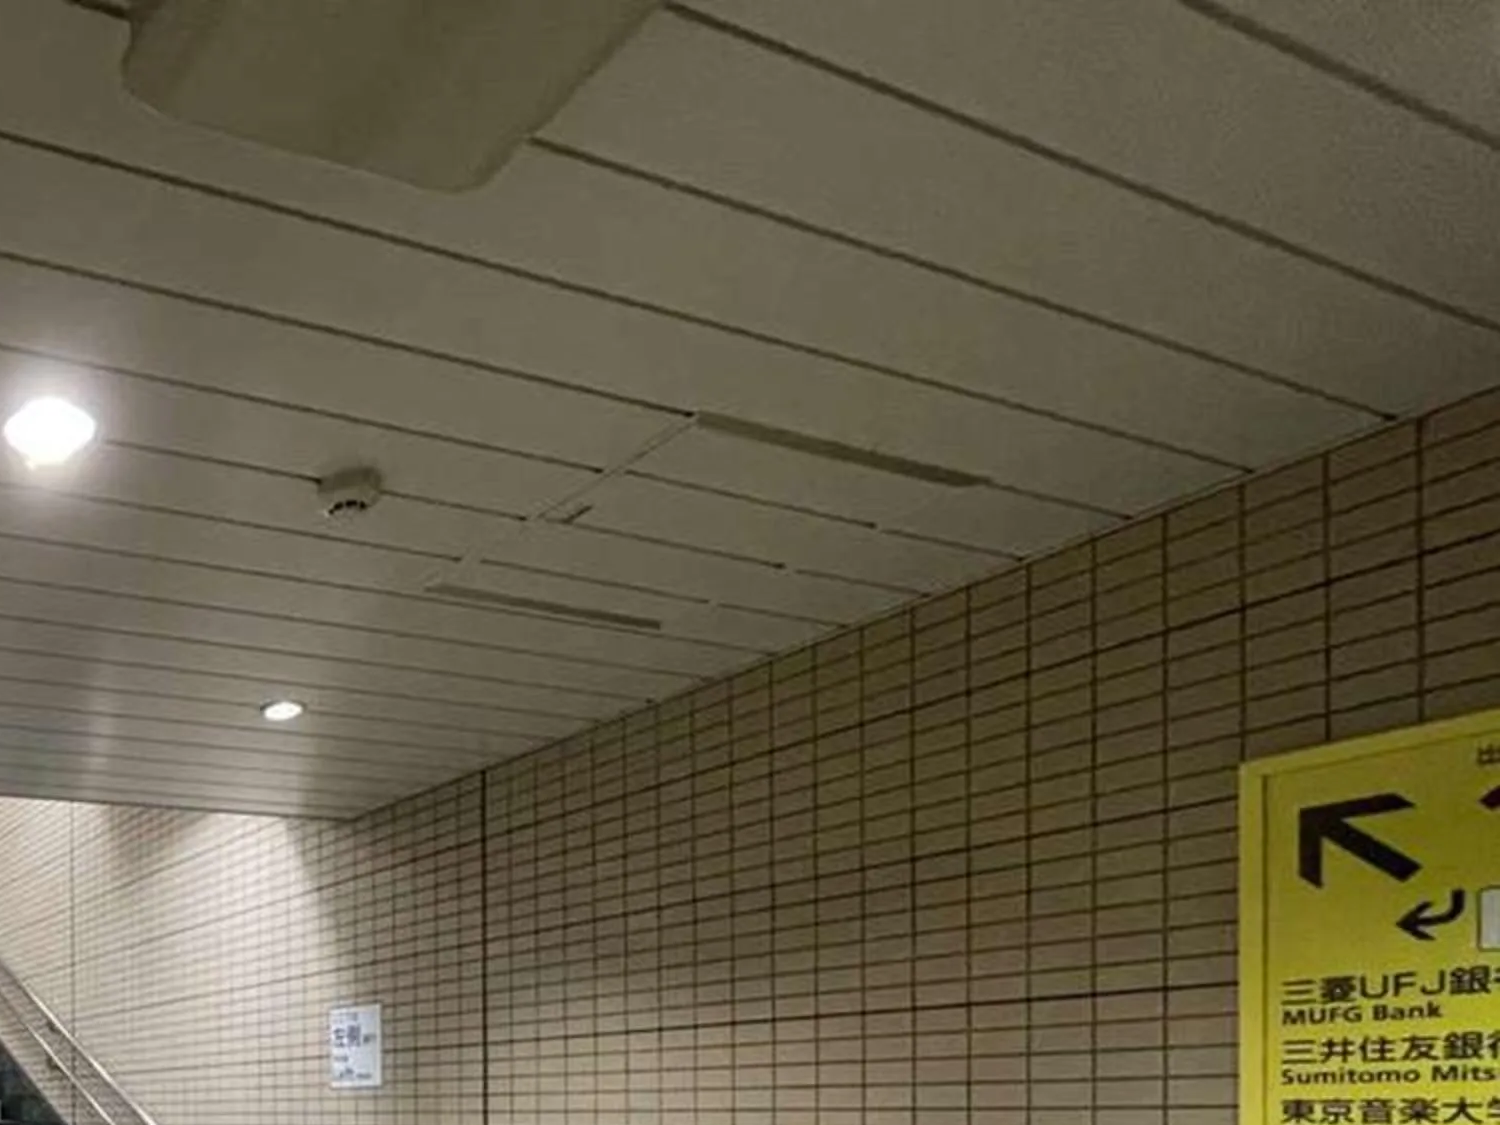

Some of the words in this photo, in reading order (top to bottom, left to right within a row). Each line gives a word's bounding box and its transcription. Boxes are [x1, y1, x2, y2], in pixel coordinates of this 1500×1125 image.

[1281, 965, 1500, 1005] 三菱UFJ銀
[1283, 1005, 1362, 1026] MUFG
[1372, 1001, 1443, 1021] Bank
[1281, 1065, 1421, 1085] Sumitomo
